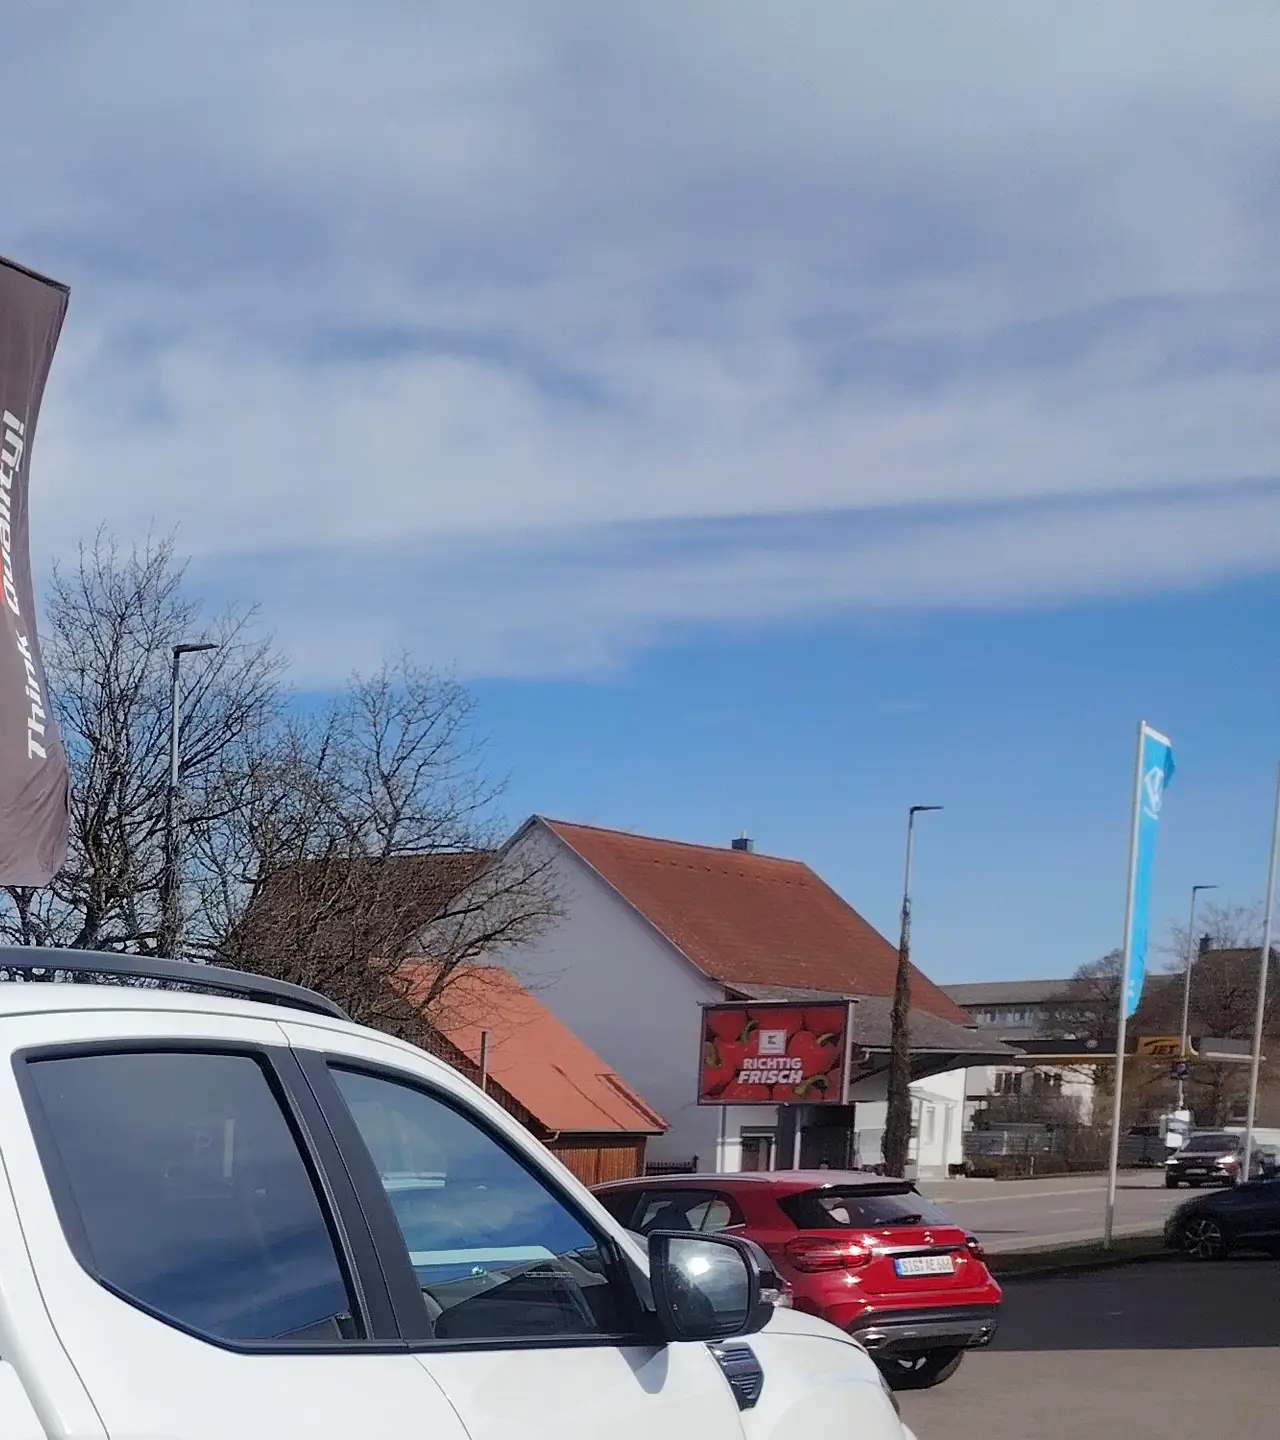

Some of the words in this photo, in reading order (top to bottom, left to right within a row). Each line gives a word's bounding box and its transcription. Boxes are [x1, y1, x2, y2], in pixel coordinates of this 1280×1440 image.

[15, 627, 47, 760] Think
[743, 1057, 802, 1069] RICHTIG
[737, 1070, 803, 1084] FRISCH
